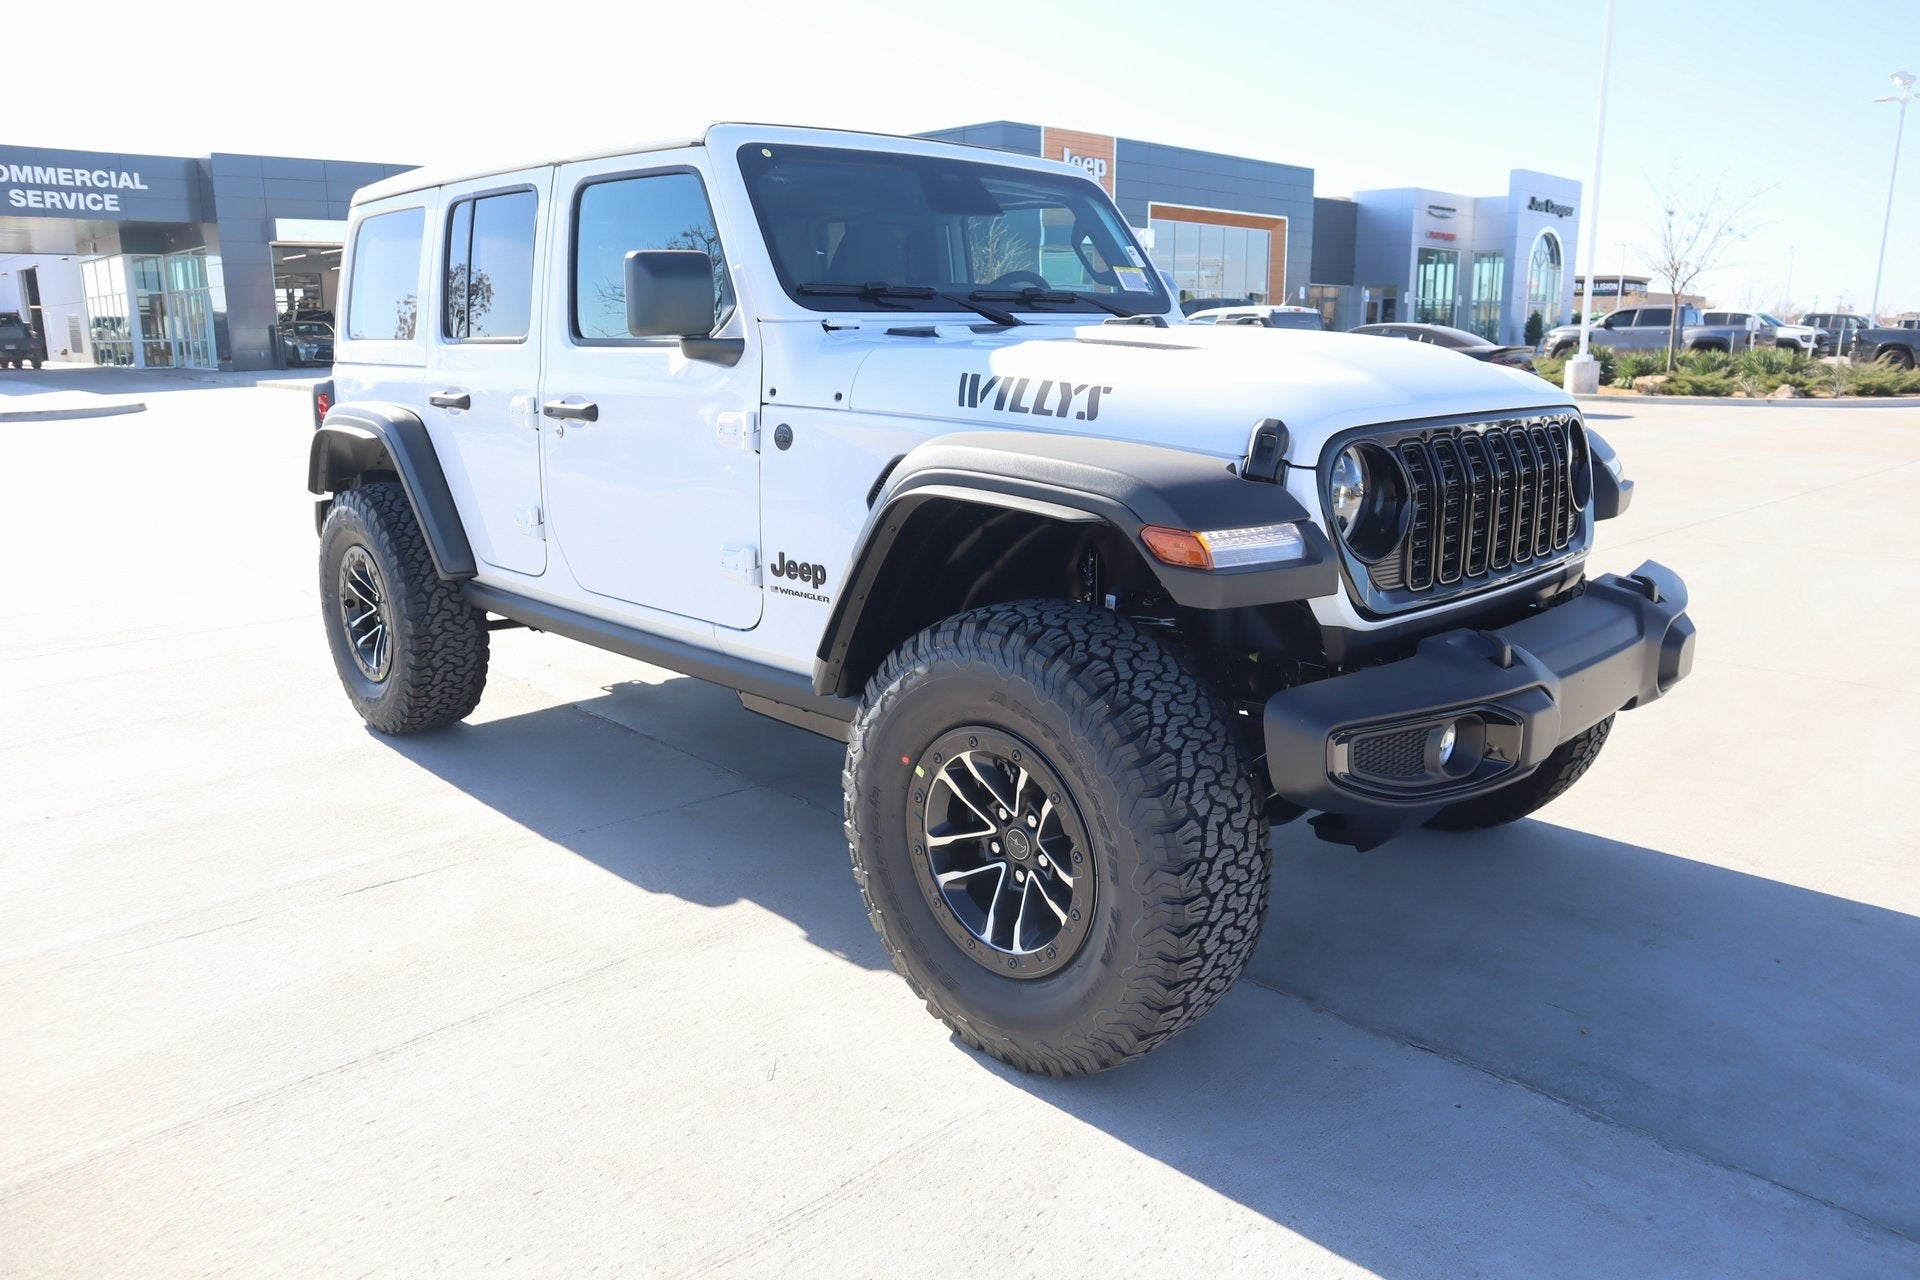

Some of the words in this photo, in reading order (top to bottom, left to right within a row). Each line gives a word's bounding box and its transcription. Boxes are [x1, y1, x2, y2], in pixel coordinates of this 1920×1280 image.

[9, 189, 121, 212] SERVICE
[958, 372, 1113, 422] WILLYS
[770, 551, 827, 590] Jeep
[779, 586, 830, 603] WRANGLER
